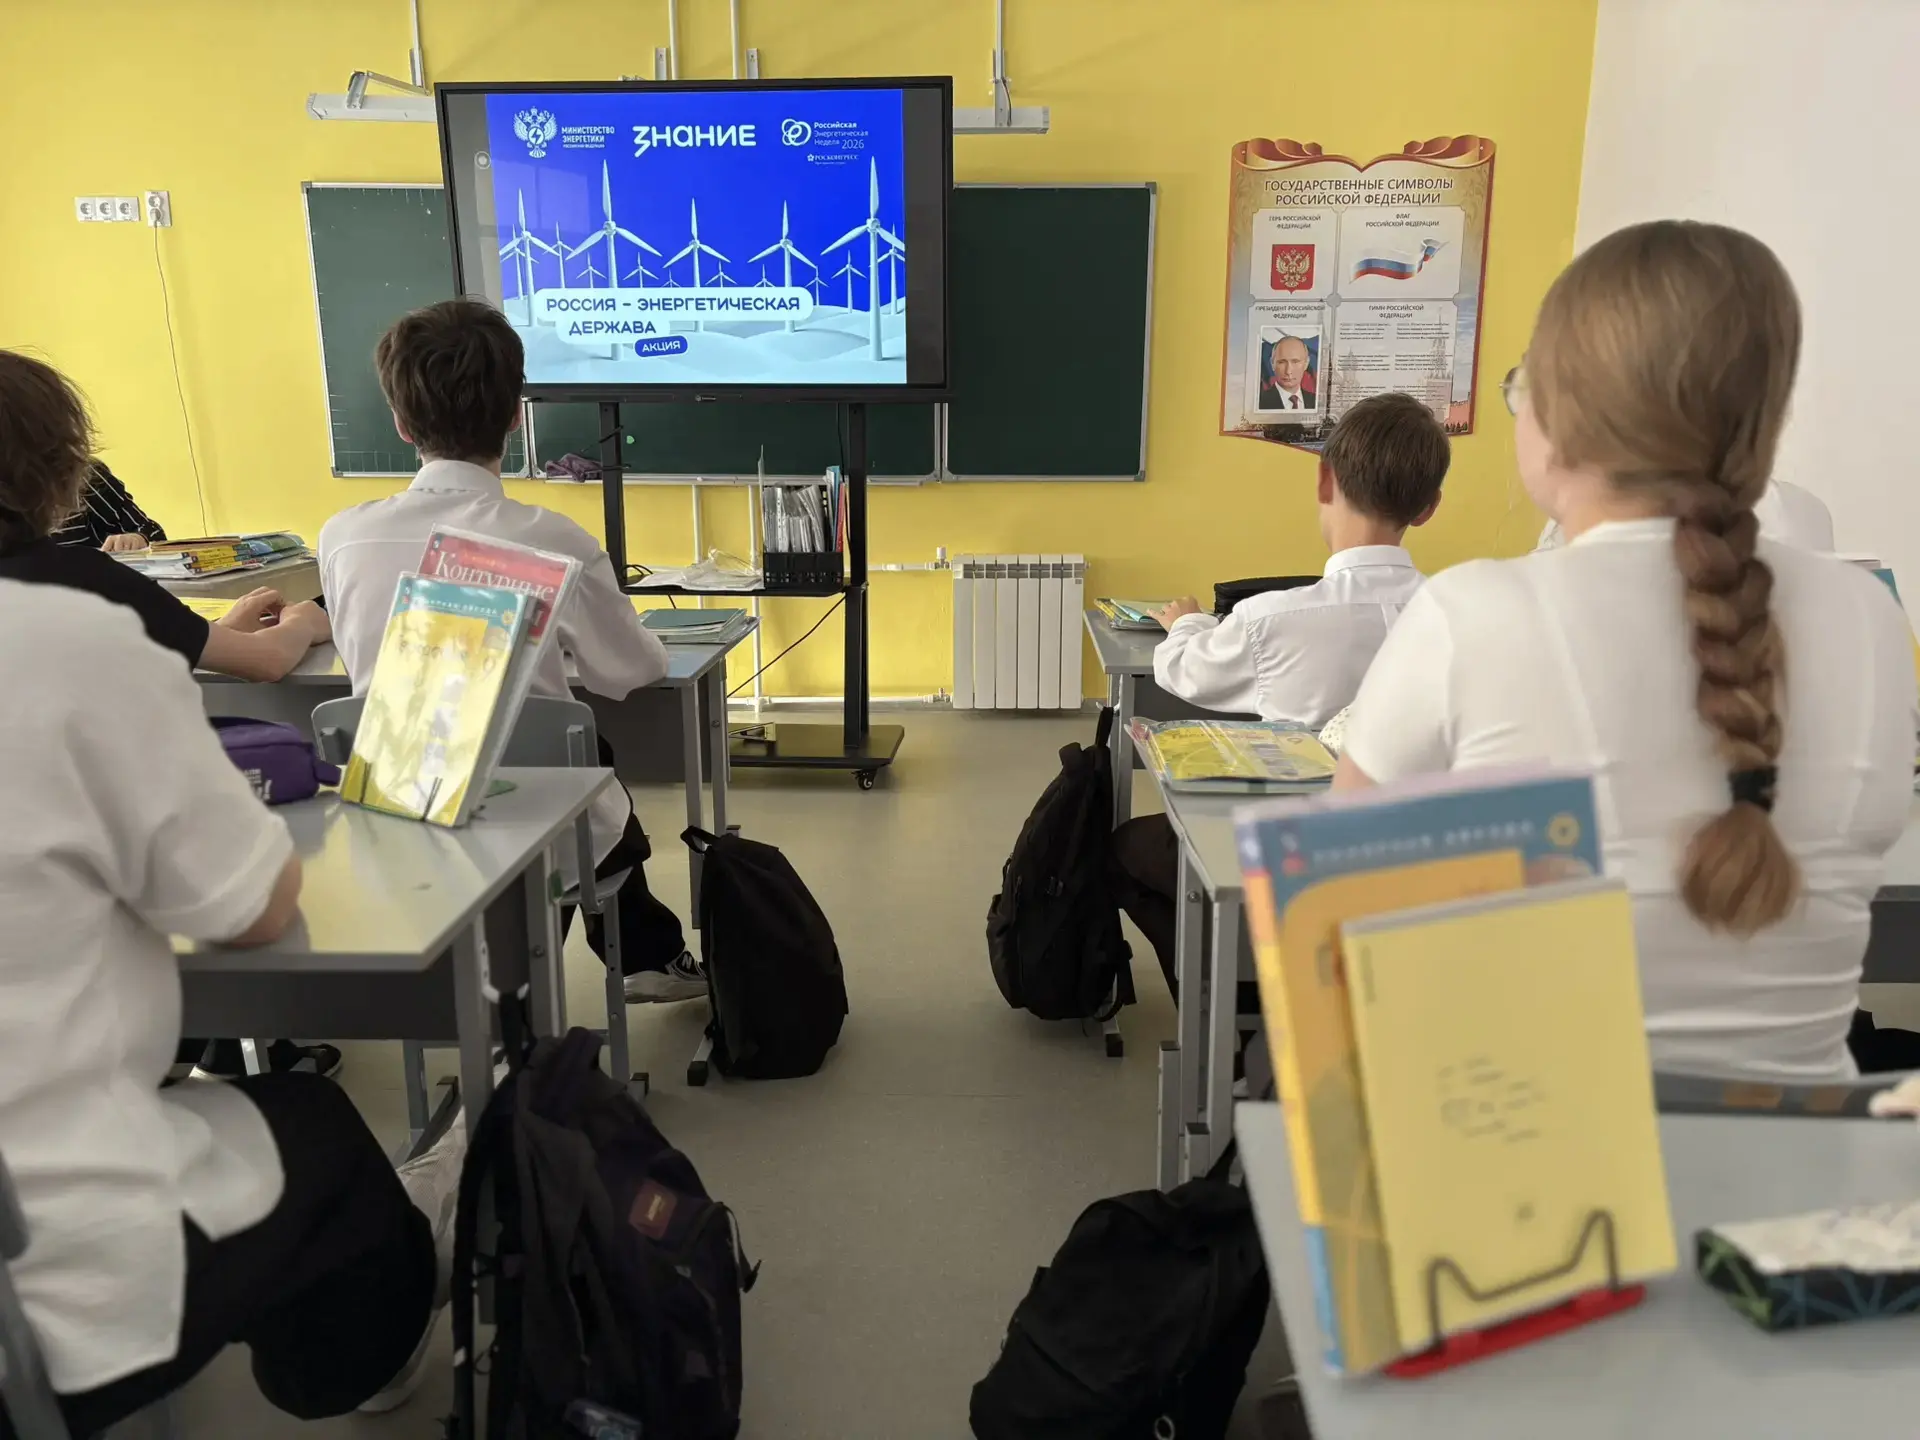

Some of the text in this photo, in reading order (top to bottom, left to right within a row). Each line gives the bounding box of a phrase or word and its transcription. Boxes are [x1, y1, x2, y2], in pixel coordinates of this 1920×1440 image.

[814, 121, 857, 129] Российская
[561, 126, 615, 134] МИНИСТЕРСТВО
[814, 130, 869, 138] Энергетическая
[562, 135, 605, 143] ЭНЕРГЕТИКИ
[842, 139, 865, 149] 2026
[1265, 178, 1453, 192] ГОСУДАРСТВЕННЫЕ СИМВОЛЫ
[1276, 191, 1441, 207] РОССИЙСКОЙ ФЕДЕРАЦИИ
[546, 298, 616, 311] РОССИЯ
[637, 297, 801, 311] ЭНЕРГЕТИЧЕСКАЯ
[1288, 303, 1325, 311] РОССИЙСКОЙ
[1386, 303, 1424, 311] РОССИЙСКОЙ
[569, 320, 657, 336] ДЕРЖАВА
[642, 340, 681, 353] АКЦИЯ
